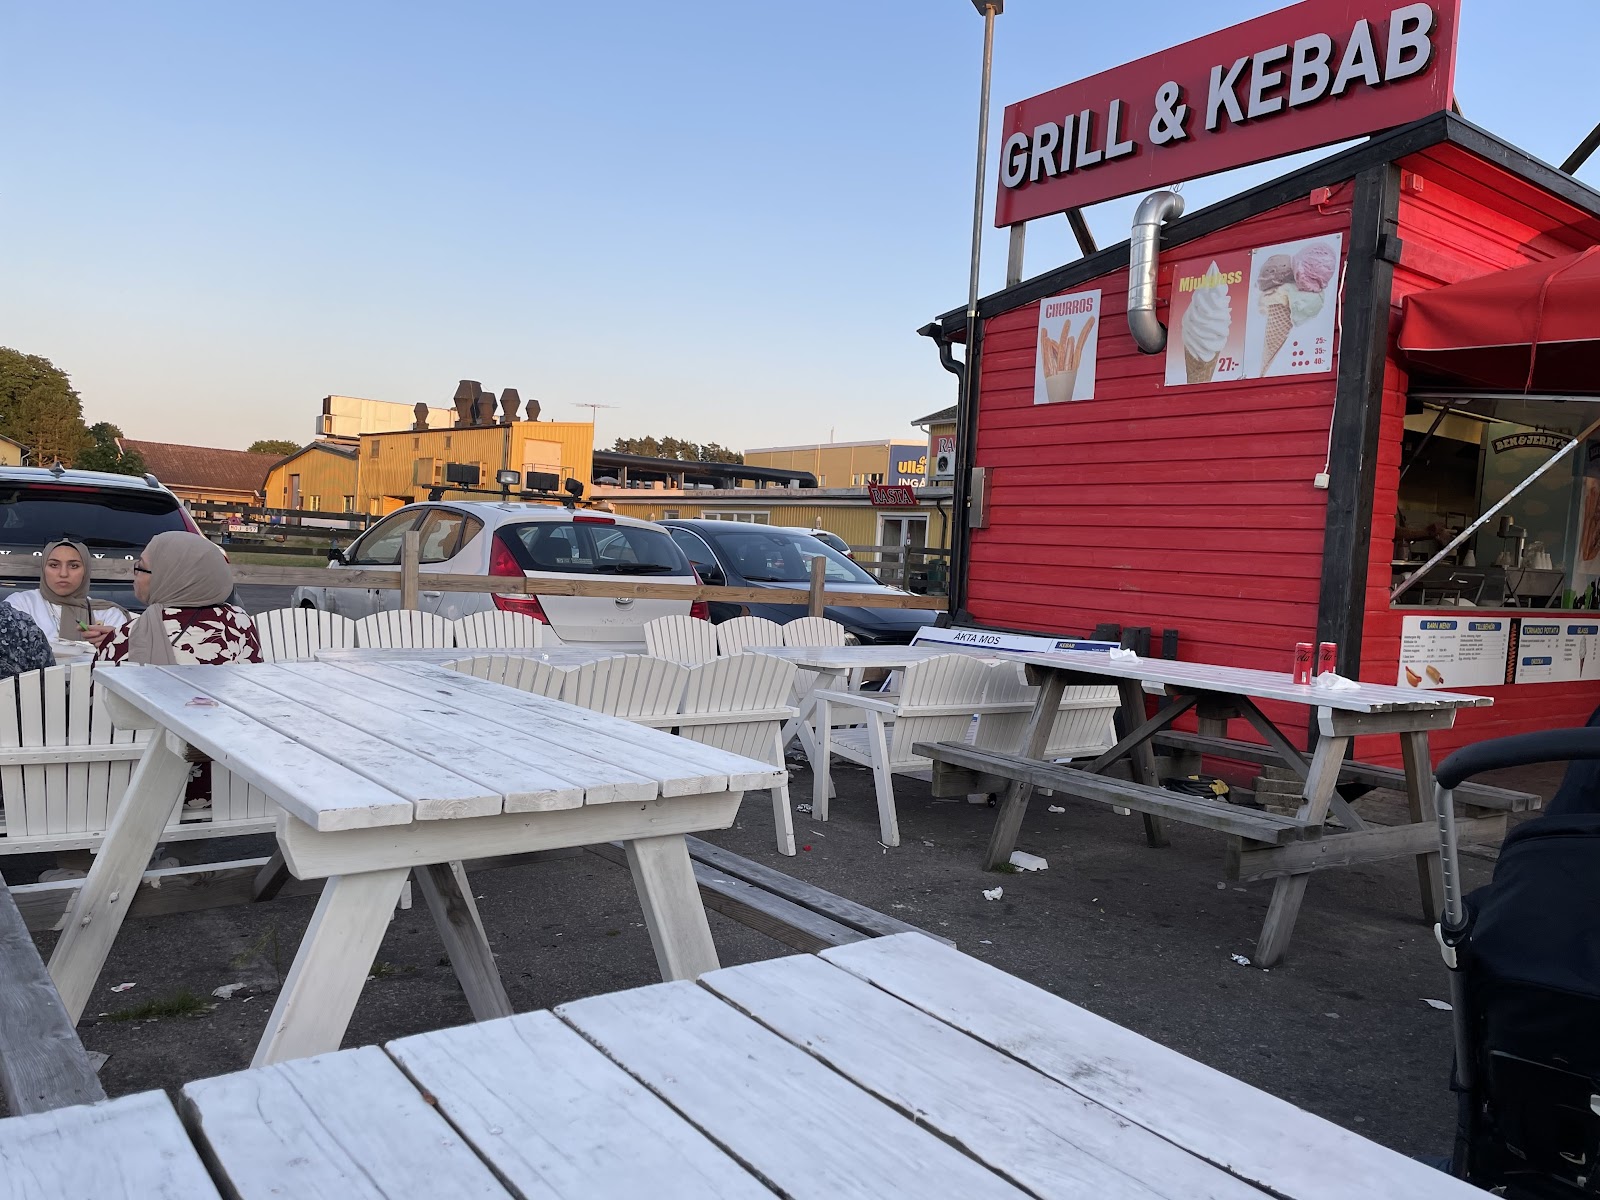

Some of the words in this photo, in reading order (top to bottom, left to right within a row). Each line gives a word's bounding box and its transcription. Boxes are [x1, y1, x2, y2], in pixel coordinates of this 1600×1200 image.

[1001, 99, 1134, 189] GRILL
[1148, 80, 1188, 145] &
[1205, 3, 1436, 130] KEBAB
[1045, 297, 1094, 319] CHURROS
[1218, 357, 1239, 373] 27:-
[872, 488, 913, 504] RASTA
[978, 635, 1001, 645] MOS
